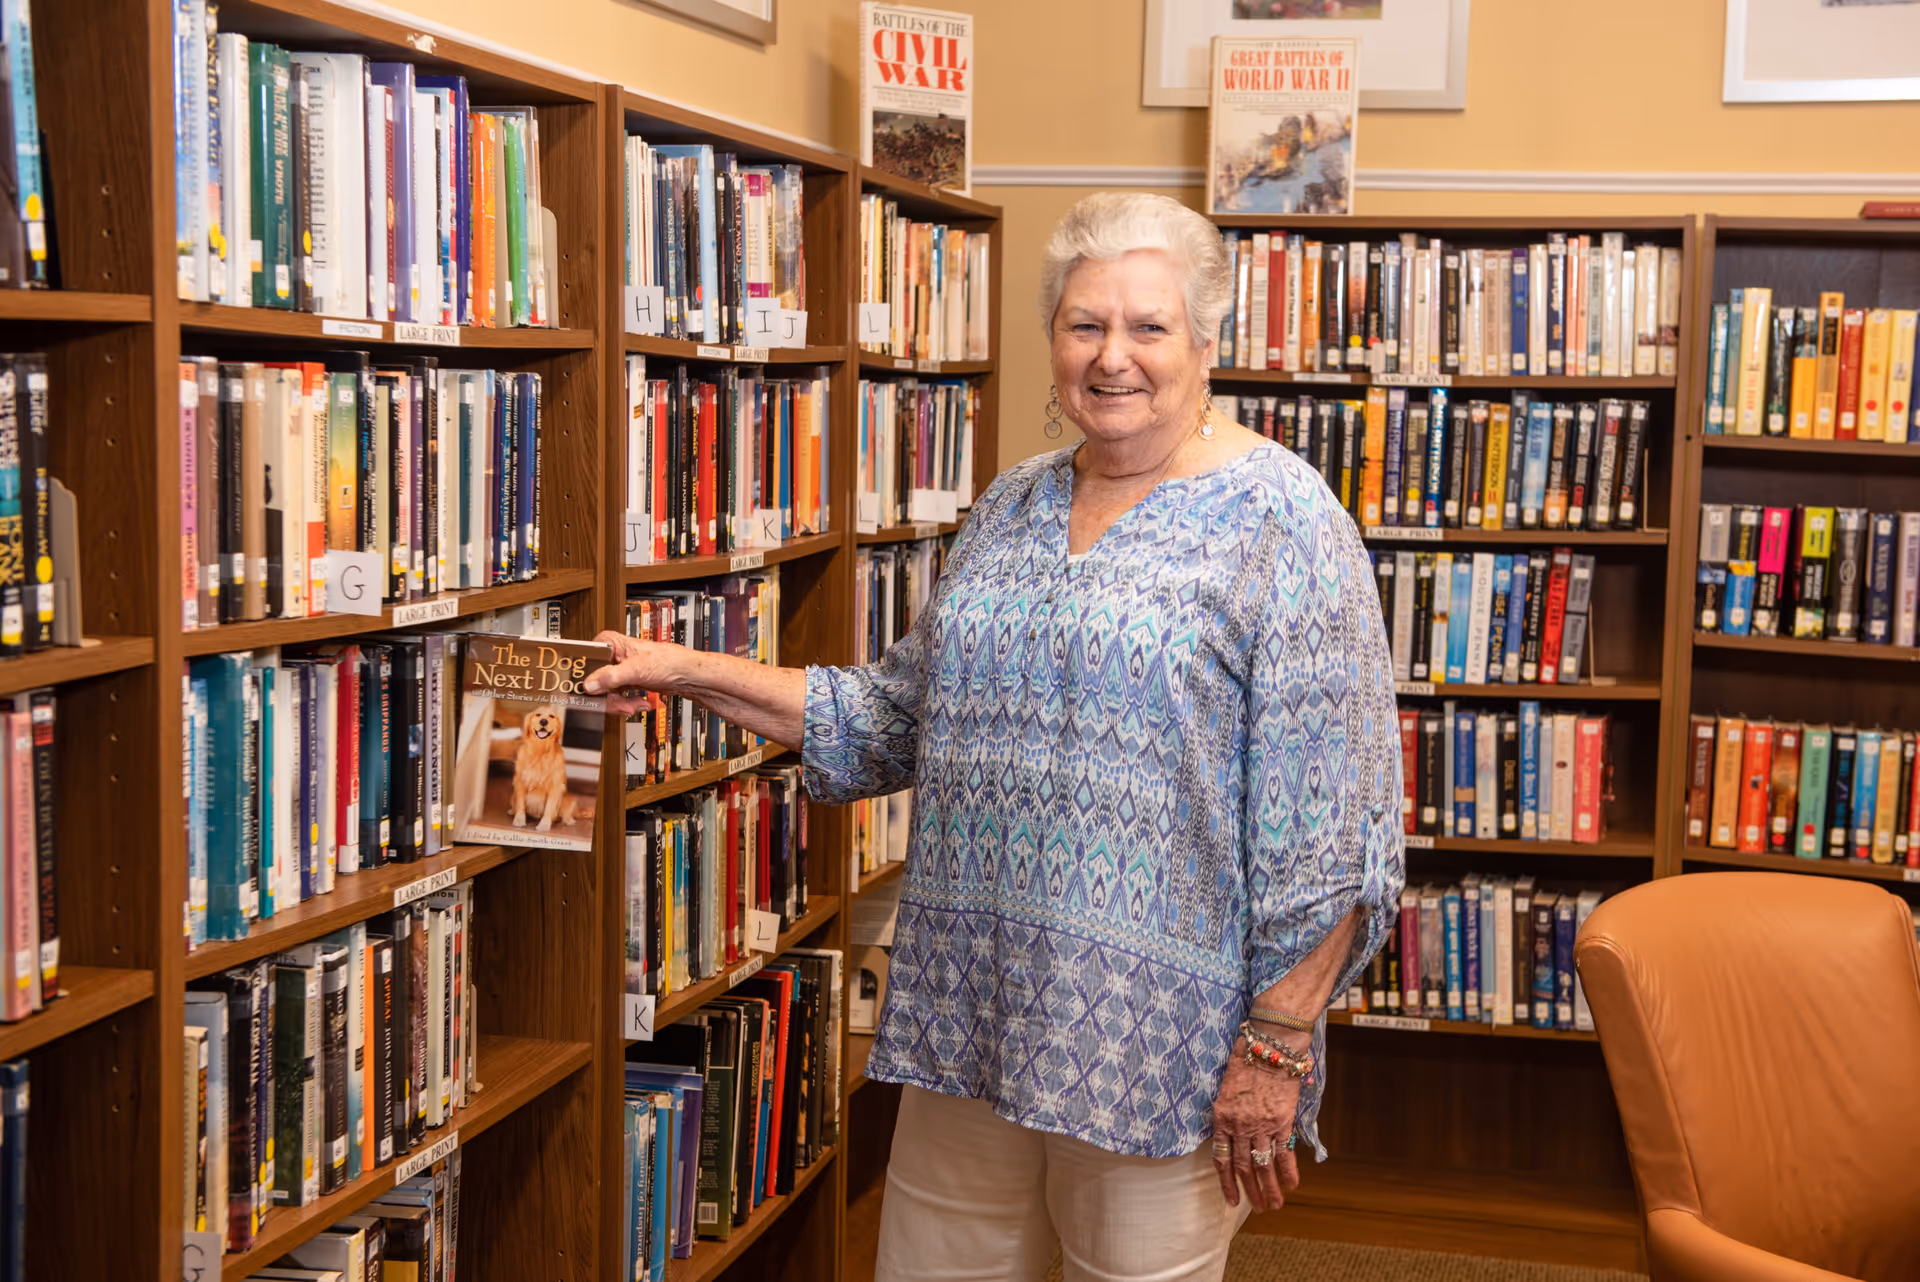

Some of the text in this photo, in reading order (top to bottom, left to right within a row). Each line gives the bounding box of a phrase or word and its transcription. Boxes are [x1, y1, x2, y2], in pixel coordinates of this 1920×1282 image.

[873, 13, 967, 37] BATTLES OF THE
[872, 29, 967, 70] CIVIL
[1231, 50, 1344, 66] GREAT BATTLES OF
[873, 60, 965, 91] WAR
[1224, 68, 1349, 91] WORLD WAR II
[635, 295, 651, 323] H
[756, 310, 772, 333] I
[781, 317, 797, 340] J
[867, 311, 880, 333] L
[399, 325, 457, 343] LARGE PRINT
[736, 347, 768, 360] LARGE PRINT
[1375, 374, 1447, 385] LARGE PRINT
[1511, 417, 1524, 471] Cat & Mouse
[1428, 429, 1443, 494] PATTERSON
[1490, 436, 1501, 488] PATTERSON
[625, 522, 641, 553] J
[762, 517, 777, 541] K
[1369, 526, 1440, 539] LARGE PRINT
[731, 554, 763, 570] LARGE PRINT
[340, 564, 366, 601] G
[398, 601, 456, 625] LARGE PRINT
[491, 643, 587, 679] The Dog
[472, 662, 587, 695] Next Doo
[1400, 684, 1431, 694] PRINT
[483, 689, 506, 700] Other
[507, 690, 533, 702] Stories
[550, 693, 569, 706] Dogs
[569, 696, 582, 706] We
[581, 698, 600, 708] Love
[380, 693, 389, 754] GRIPPANDO
[658, 708, 667, 745] GONE
[624, 741, 639, 763] K
[730, 751, 761, 772] LARGE PRINT
[39, 750, 53, 803] COLIN
[527, 835, 549, 845] Smith
[1405, 836, 1429, 847] RINT
[398, 868, 455, 905] LARGE PRINT
[756, 920, 771, 941] L
[731, 957, 763, 986] LARGE PRINT
[634, 1002, 650, 1033] K
[1356, 1014, 1426, 1030] LARGE PRINT
[383, 976, 392, 1117] APPEAL JOHN GRISHAM
[399, 1136, 456, 1182] LARGE PRINT
[451, 1191, 459, 1244] HILLERMAN
